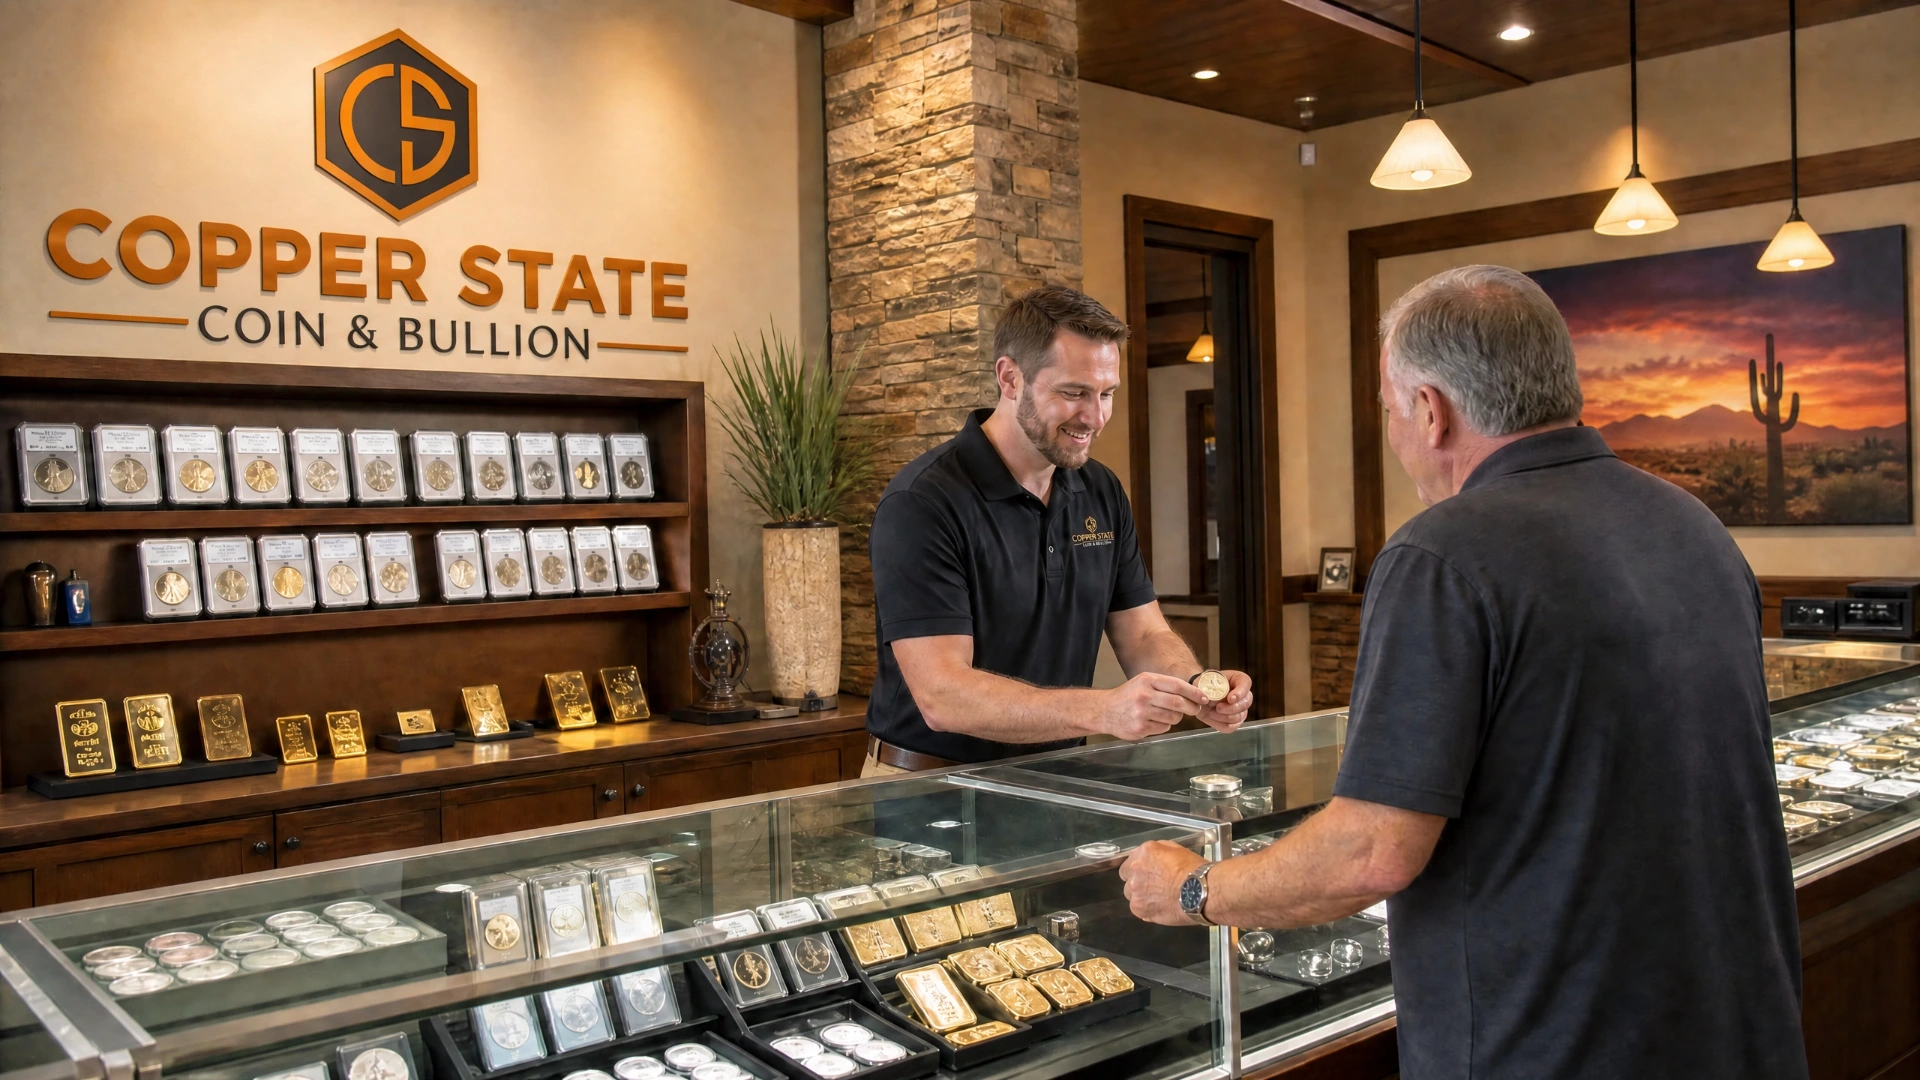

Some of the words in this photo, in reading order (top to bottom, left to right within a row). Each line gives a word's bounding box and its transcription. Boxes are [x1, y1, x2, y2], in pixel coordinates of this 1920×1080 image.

[338, 63, 457, 186] CS
[47, 208, 428, 302] COPPER
[458, 244, 689, 319] STATE
[198, 304, 326, 347] COIN
[347, 314, 379, 349] &
[399, 316, 590, 360] BULLION
[1072, 533, 1097, 542] COPPER
[1097, 531, 1115, 540] STATE
